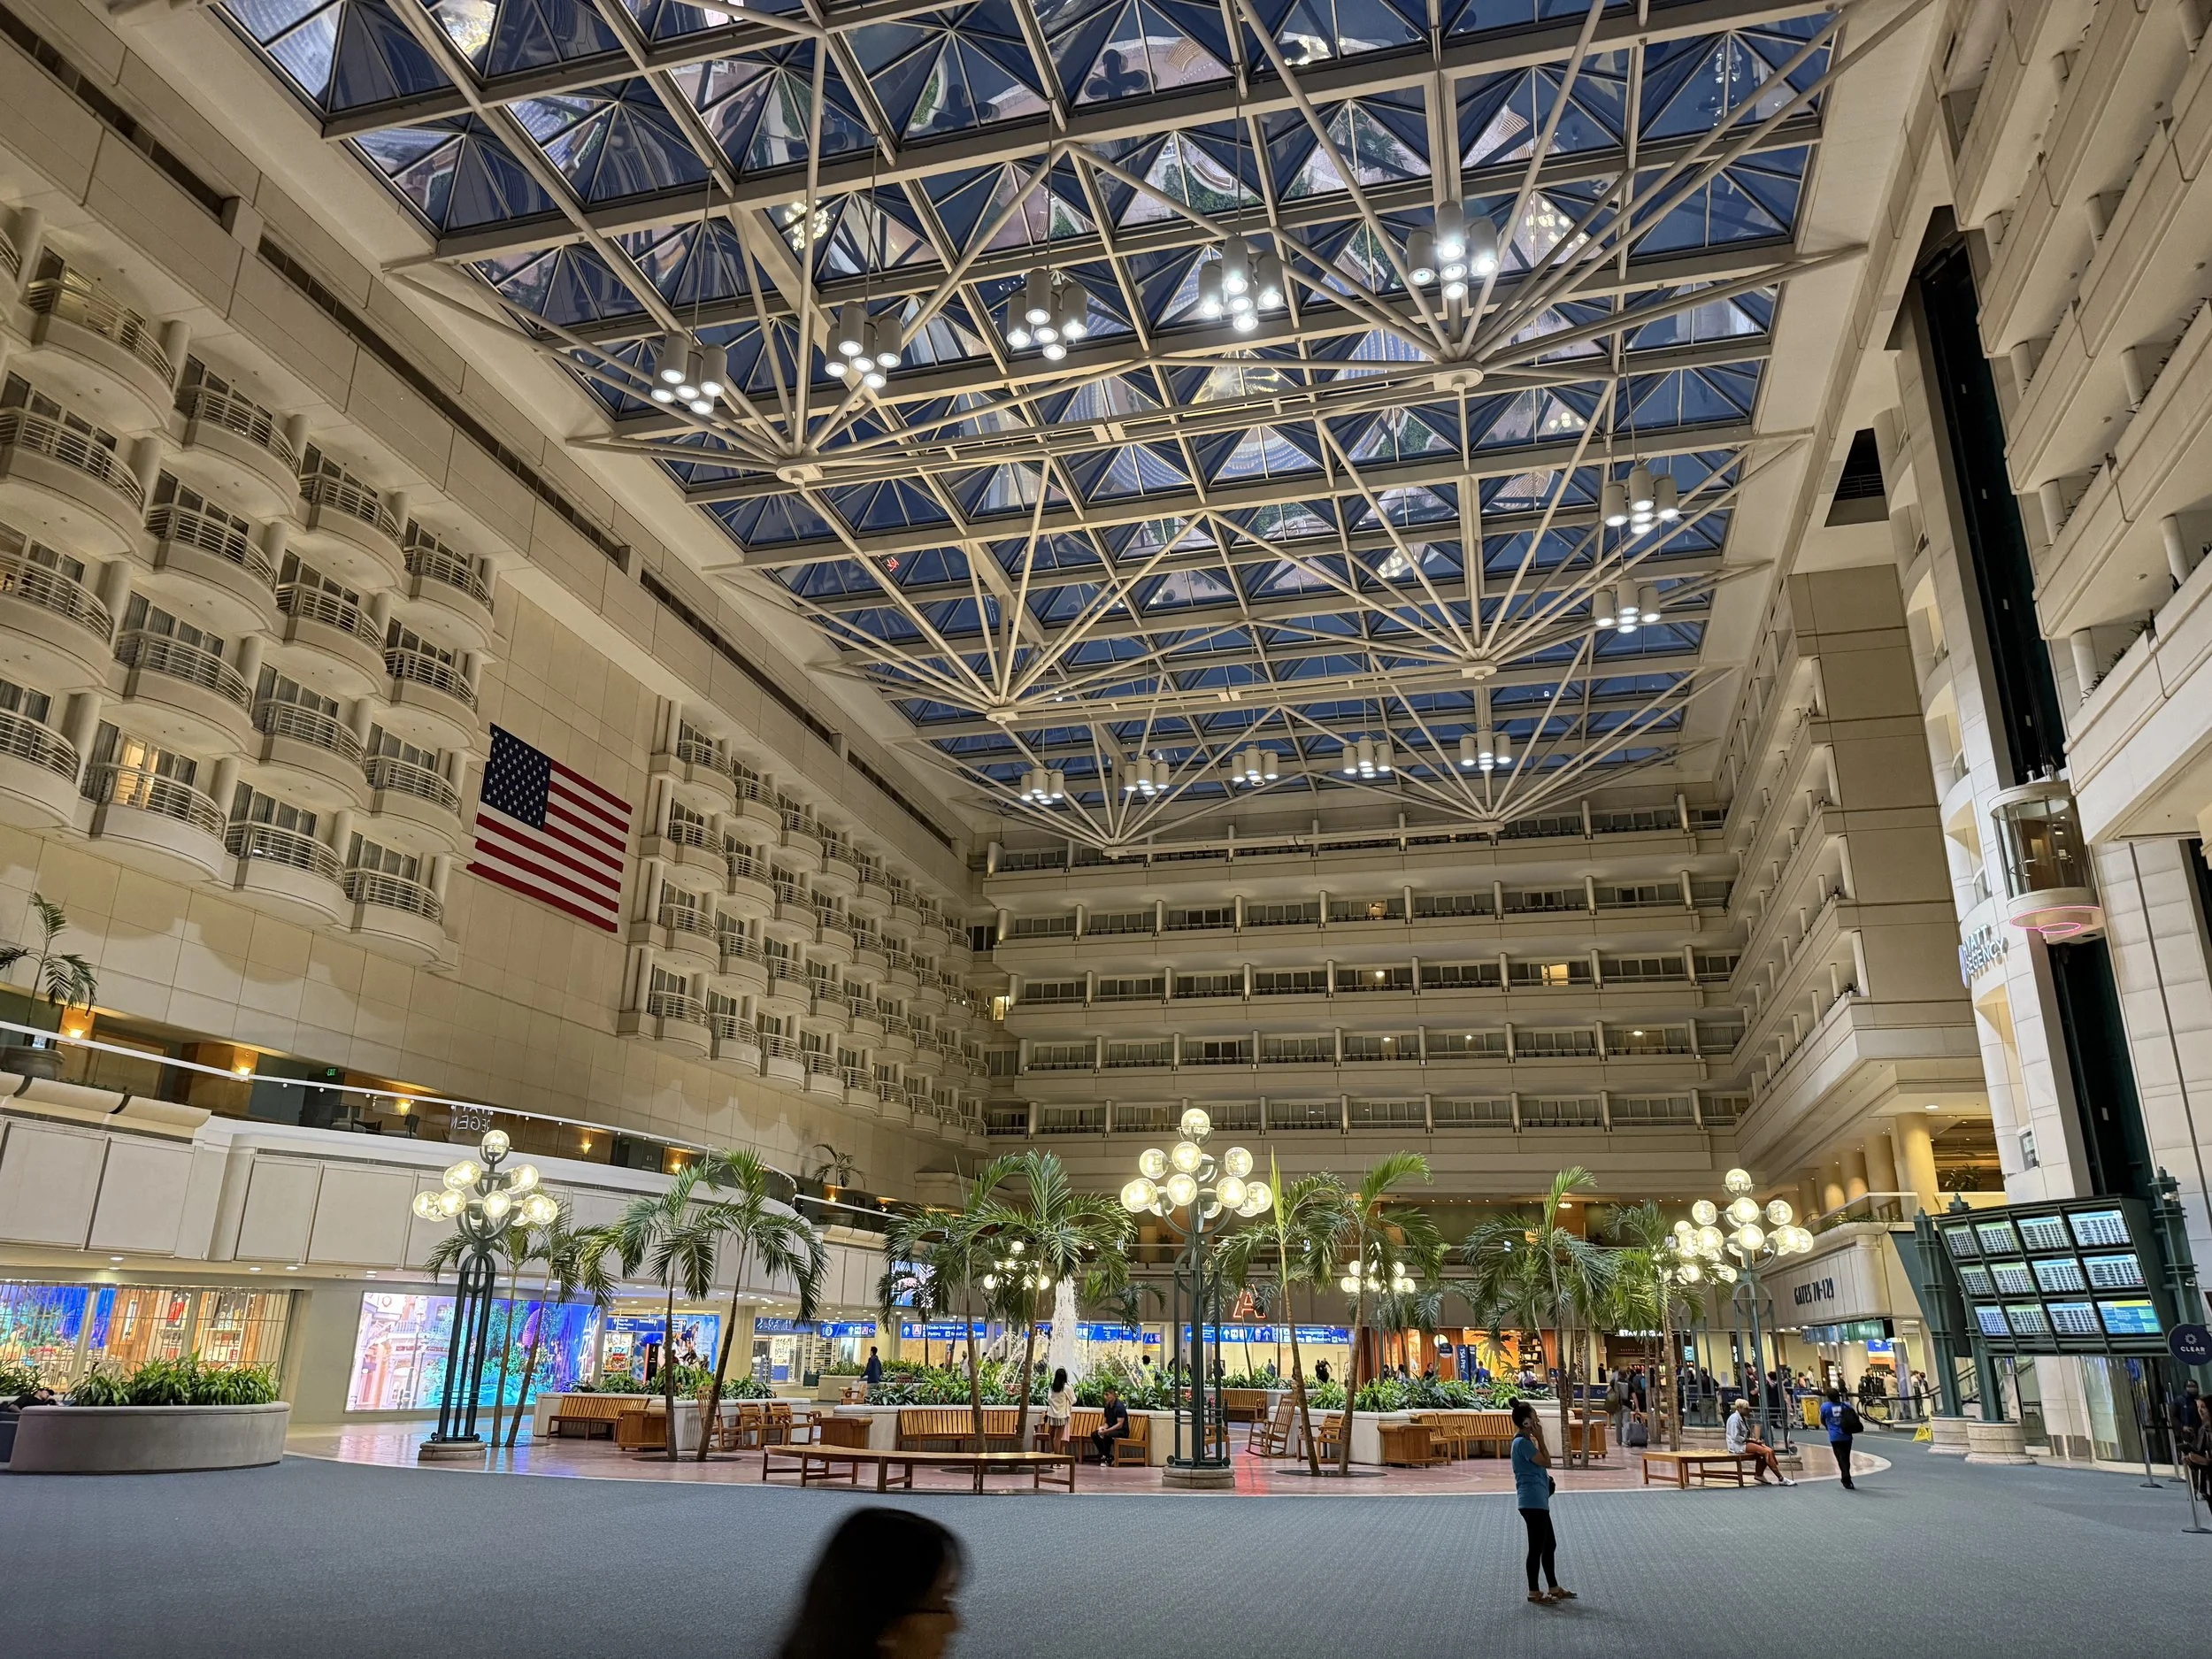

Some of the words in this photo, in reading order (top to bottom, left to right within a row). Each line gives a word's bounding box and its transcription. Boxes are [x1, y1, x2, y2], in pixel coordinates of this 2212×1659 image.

[1966, 937, 2004, 975] REGENCY
[1233, 1282, 1266, 1318] A
[1794, 1283, 1812, 1306] GATES
[1812, 1277, 1834, 1302] 70-129
